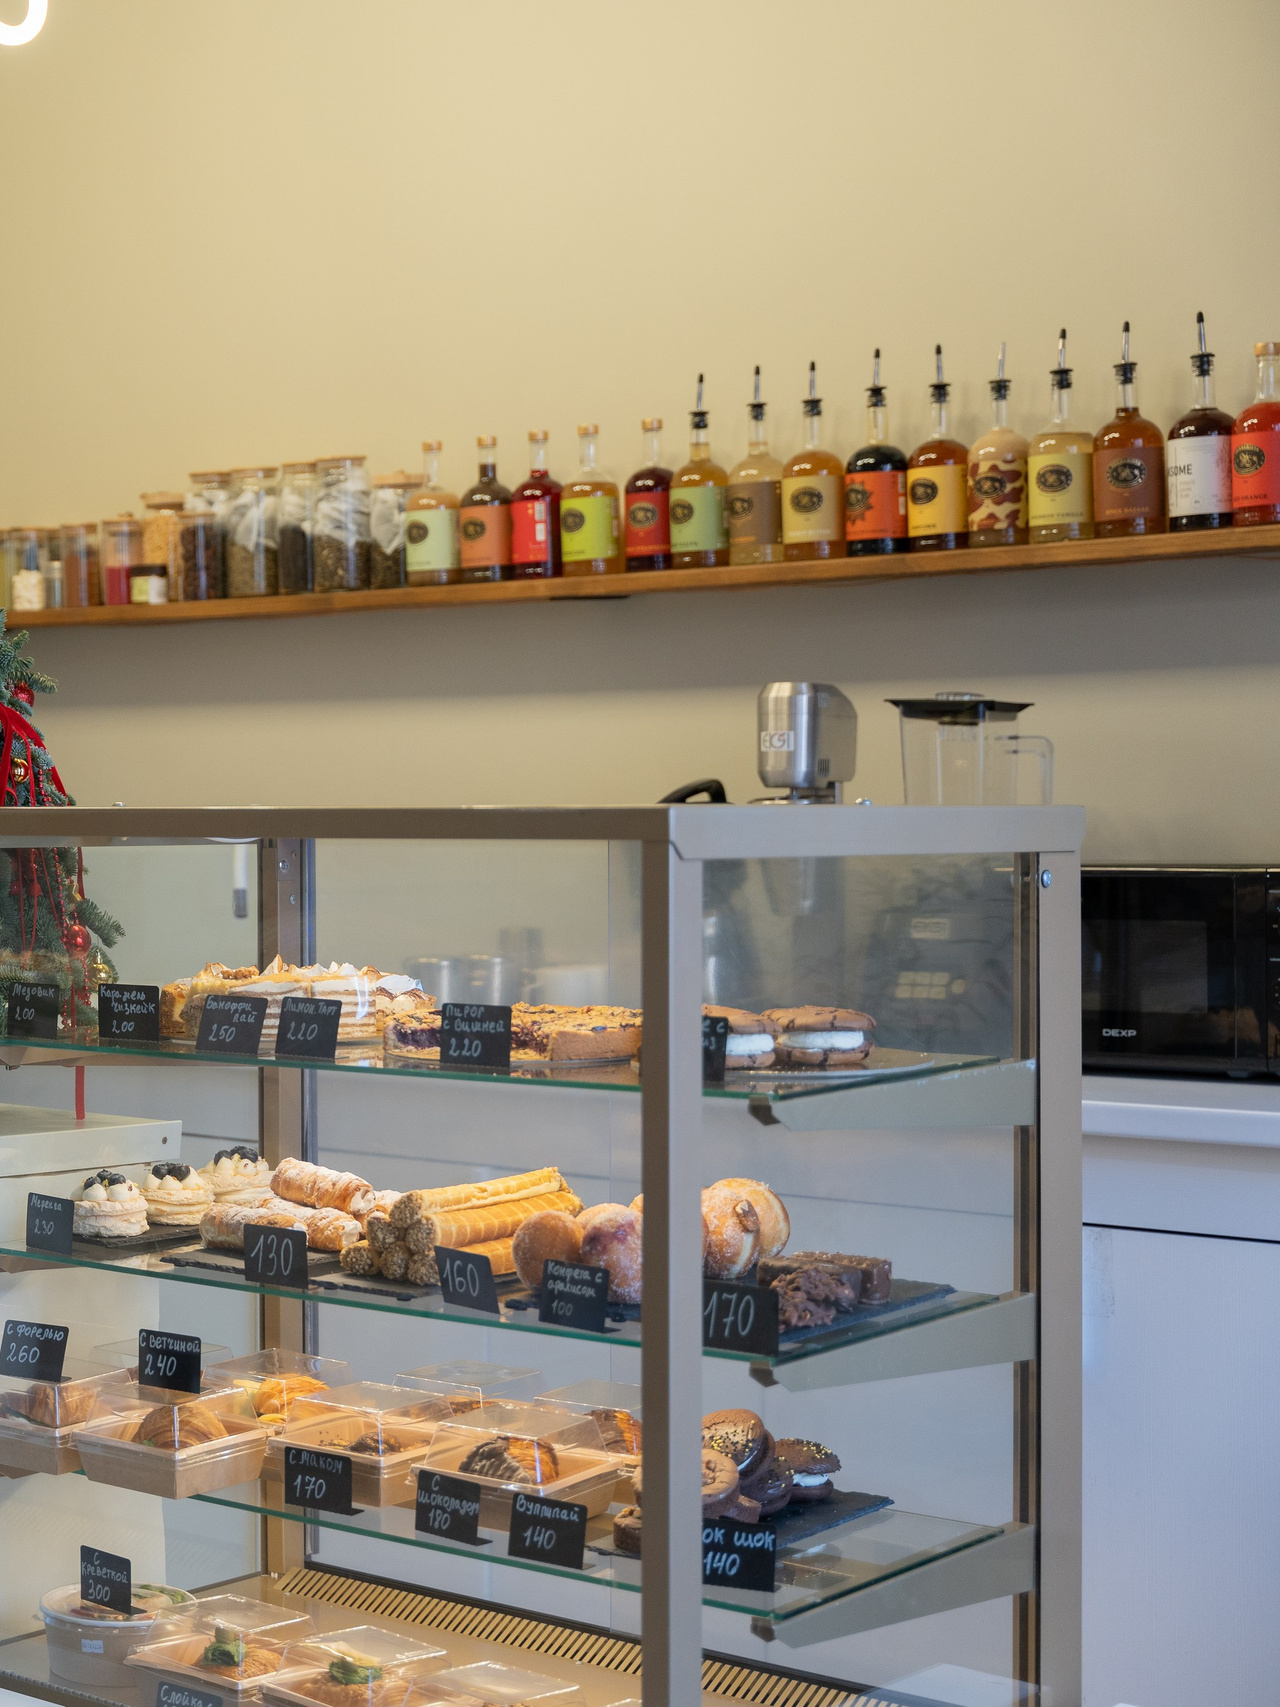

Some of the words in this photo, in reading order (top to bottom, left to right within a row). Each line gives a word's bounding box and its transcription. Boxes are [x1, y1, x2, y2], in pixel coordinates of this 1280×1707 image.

[1168, 463, 1193, 476] SOME
[12, 984, 55, 1001] Медовик
[14, 1006, 35, 1021] 200
[205, 995, 252, 1014] Баноффи
[112, 1020, 135, 1034] 200
[232, 1011, 258, 1023] пай
[208, 1023, 236, 1043] 250
[286, 1021, 318, 1041] 220
[1102, 1028, 1137, 1037] DEXP
[449, 1037, 482, 1058] 220
[30, 1194, 62, 1212] Меренга
[34, 1218, 55, 1235] 230
[250, 1233, 294, 1276] 130
[442, 1257, 480, 1297] 160
[551, 1299, 573, 1316] 100
[703, 1290, 755, 1338] 170
[6, 1342, 40, 1364] 260
[144, 1353, 177, 1377] 240
[293, 1474, 326, 1499] 170
[428, 1508, 451, 1530] 180
[523, 1525, 556, 1550] 140
[733, 1530, 775, 1551] шок
[703, 1550, 740, 1576] 140
[87, 1578, 111, 1602] 300
[160, 1685, 203, 1707] Слойка
